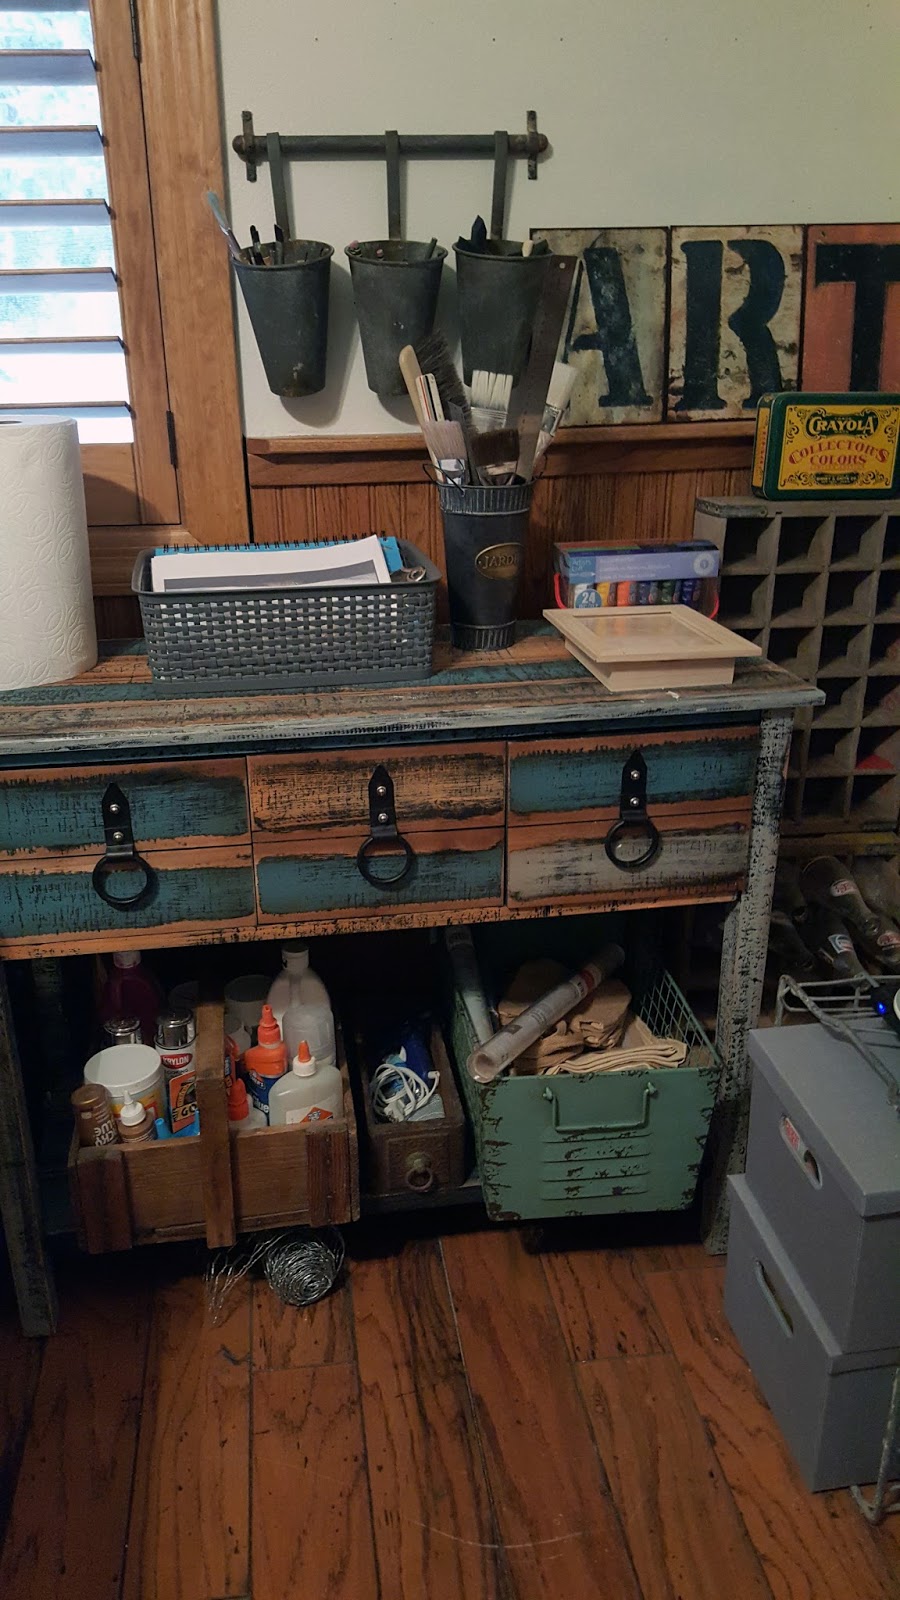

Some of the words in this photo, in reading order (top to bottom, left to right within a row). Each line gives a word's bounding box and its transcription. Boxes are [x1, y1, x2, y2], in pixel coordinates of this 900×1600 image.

[809, 416, 875, 436] CRAYOLA
[788, 439, 890, 465] COLLECTOR'S
[809, 455, 867, 466] COLORS
[482, 553, 519, 570] JARDI
[581, 591, 596, 604] 24
[162, 1055, 190, 1067] KRYLON
